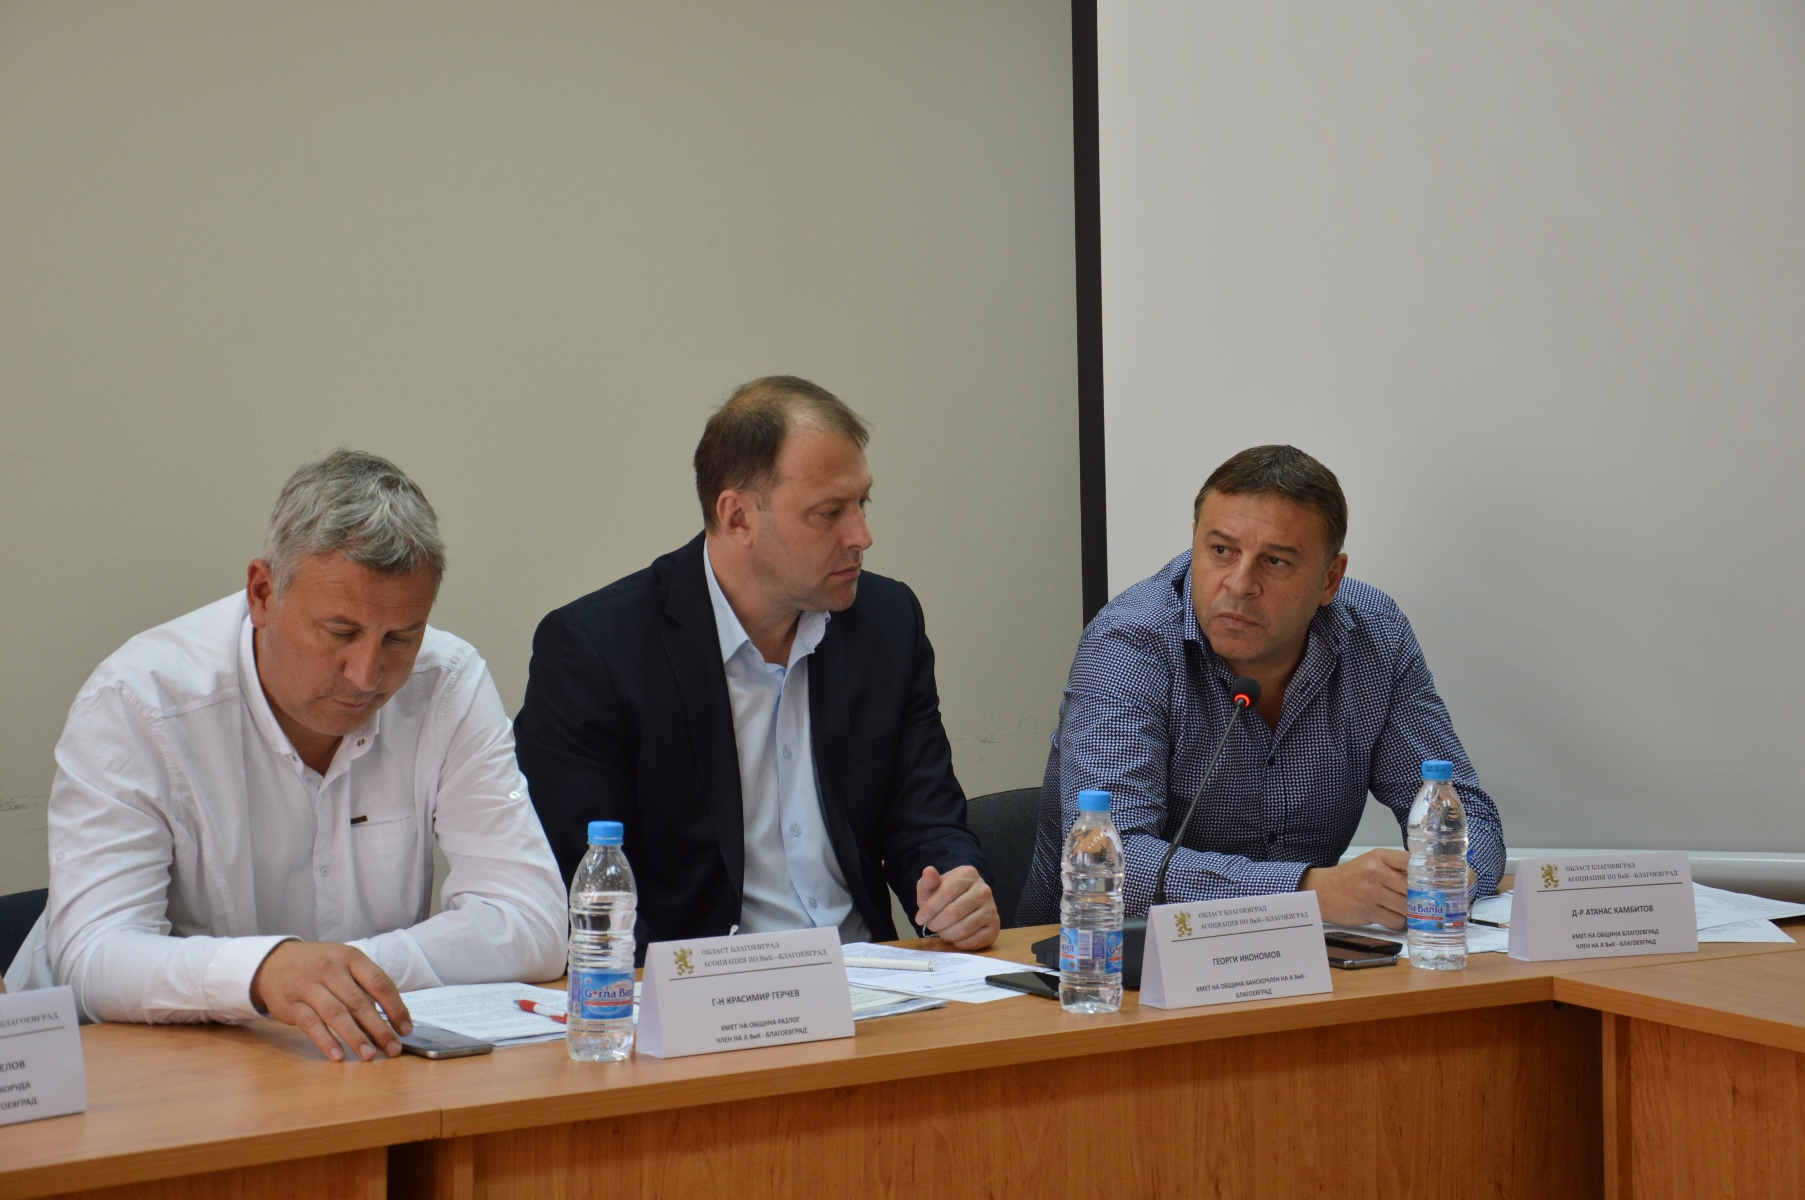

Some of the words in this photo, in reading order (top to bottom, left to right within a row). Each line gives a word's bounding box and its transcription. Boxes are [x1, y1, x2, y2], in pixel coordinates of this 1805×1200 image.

[1592, 862, 1635, 870] БЛАГОЕВГРАД
[1199, 910, 1222, 918] ОБЛАСТ
[1224, 906, 1267, 915] БЛАГОЕВГРАД
[1572, 910, 1584, 918] Д-Р
[1614, 905, 1653, 913] КАМБИТОВ
[1200, 921, 1238, 930] АСОЦИАЦИЯ
[701, 947, 728, 956] ОБЛАСТ
[731, 942, 779, 953] БЛАГОЕВГРАД
[704, 957, 746, 968] АСОЦИАЦИЯ
[1213, 956, 1238, 965] ГЕОРГИ
[1240, 951, 1281, 962] ИКОНОМОВ
[1221, 981, 1244, 989] ОБЩИНА
[712, 998, 724, 1006] Г-Н
[727, 993, 770, 1004] КРАСИМИР
[772, 989, 800, 999] ГЕРЧЕВ
[1236, 989, 1272, 998] БЛАГОЕВГРАД
[749, 1020, 776, 1028] ОБЩИНА
[766, 1028, 807, 1038] БЛАГОЕВГРАД
[0, 1097, 37, 1110] ОЕВГРАД
